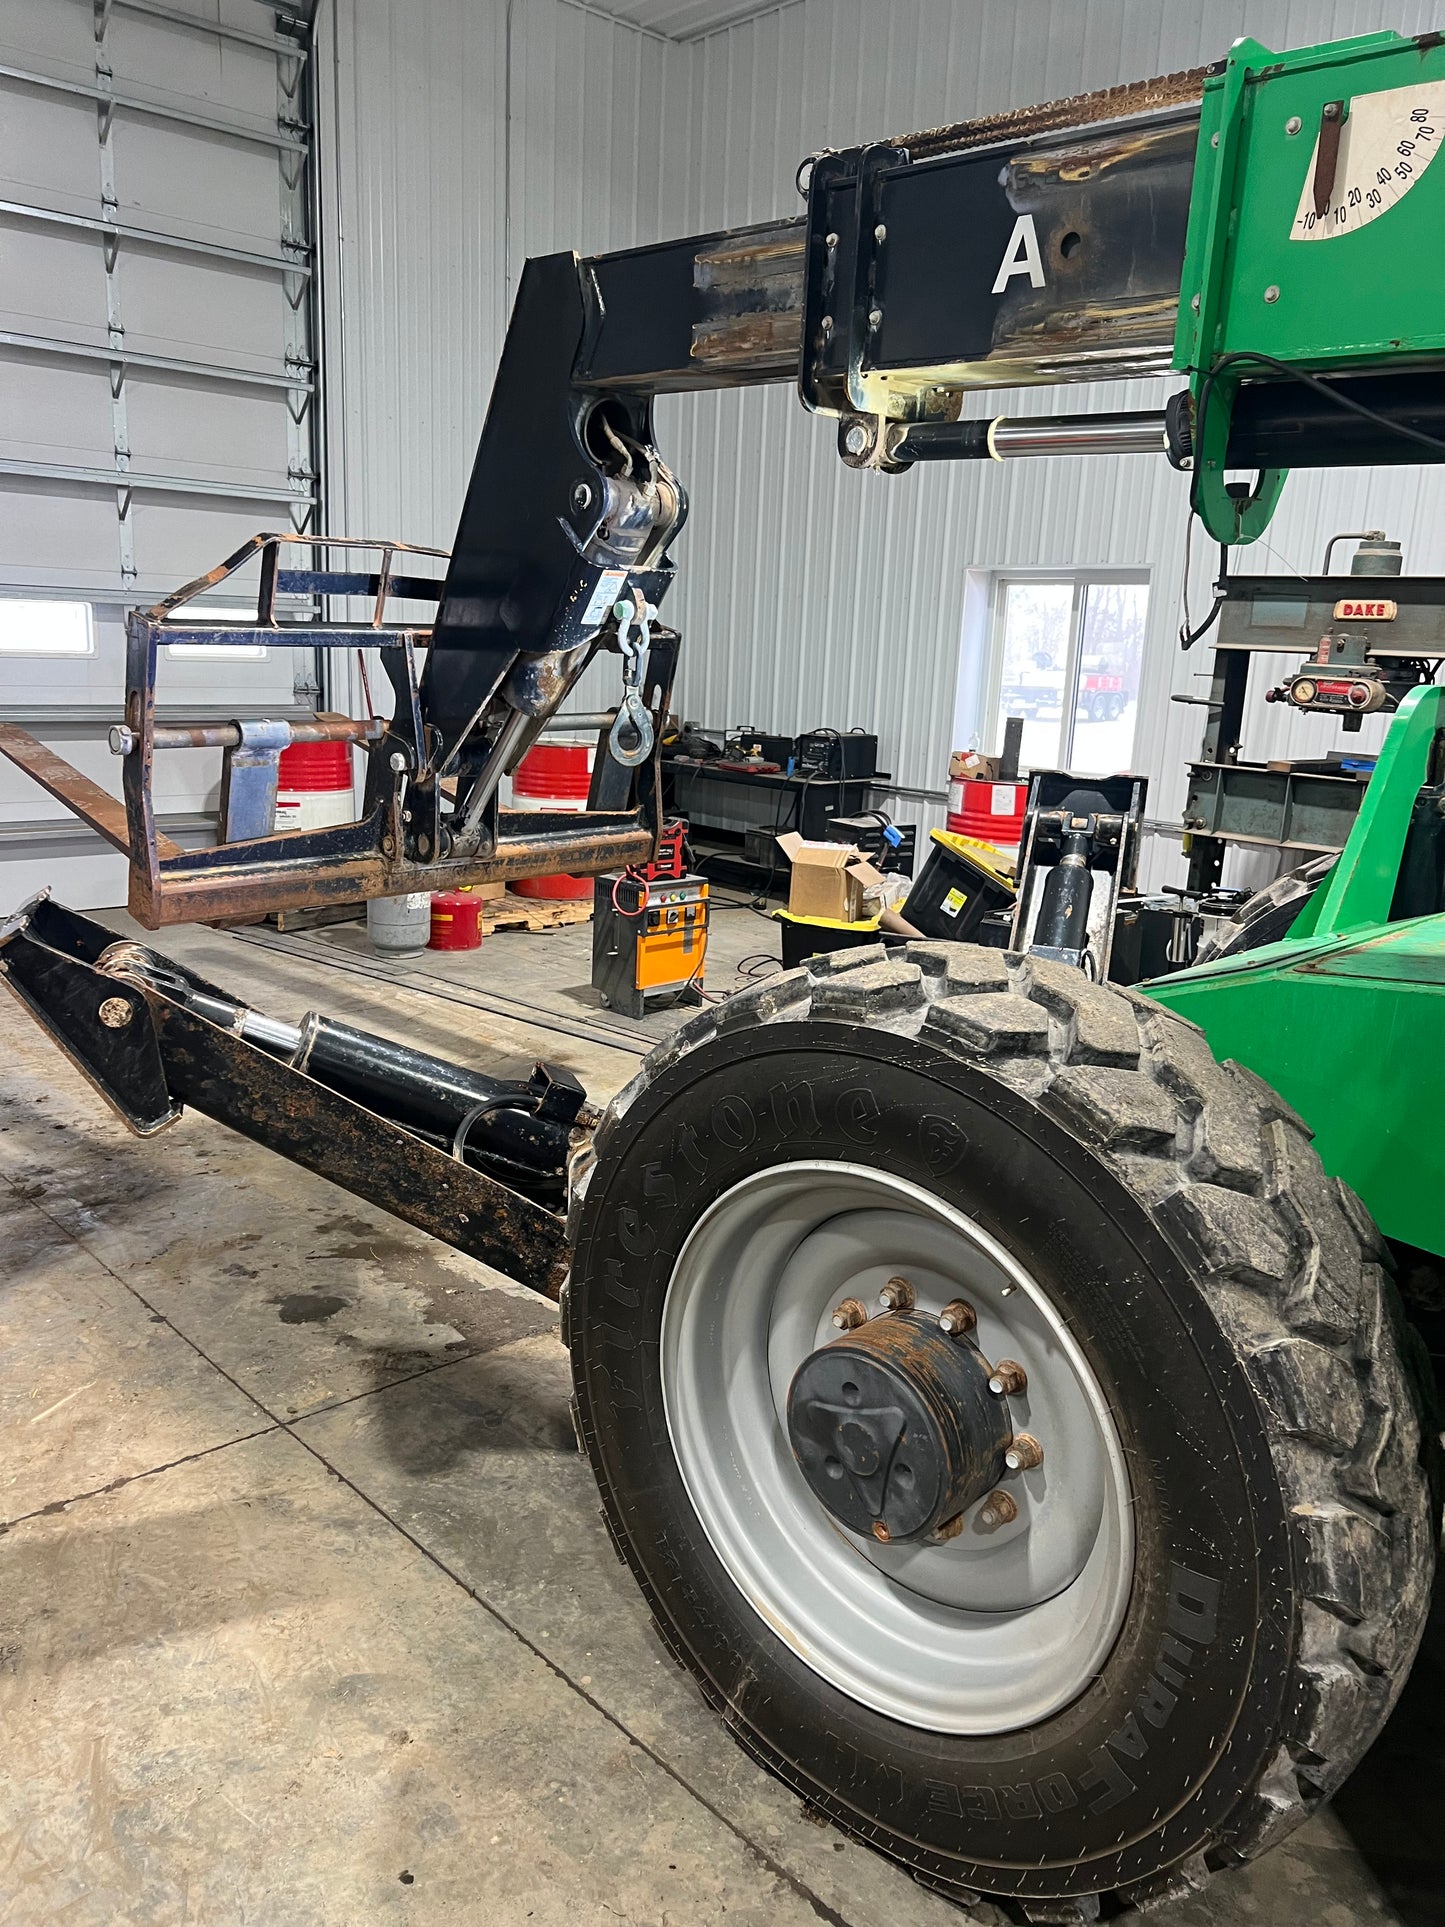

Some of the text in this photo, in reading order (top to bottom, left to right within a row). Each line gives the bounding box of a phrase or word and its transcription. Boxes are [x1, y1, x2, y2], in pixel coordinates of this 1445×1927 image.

[1410, 108, 1429, 123] 80
[1415, 126, 1435, 142] 70
[1397, 140, 1416, 157] 60
[1376, 167, 1392, 186] 40
[1394, 162, 1413, 180] 50
[1347, 187, 1362, 207] 20
[1366, 188, 1382, 209] 30
[1297, 212, 1315, 230] -10
[1334, 206, 1347, 225] 10
[991, 213, 1046, 294] A
[1343, 604, 1385, 616] DAKE
